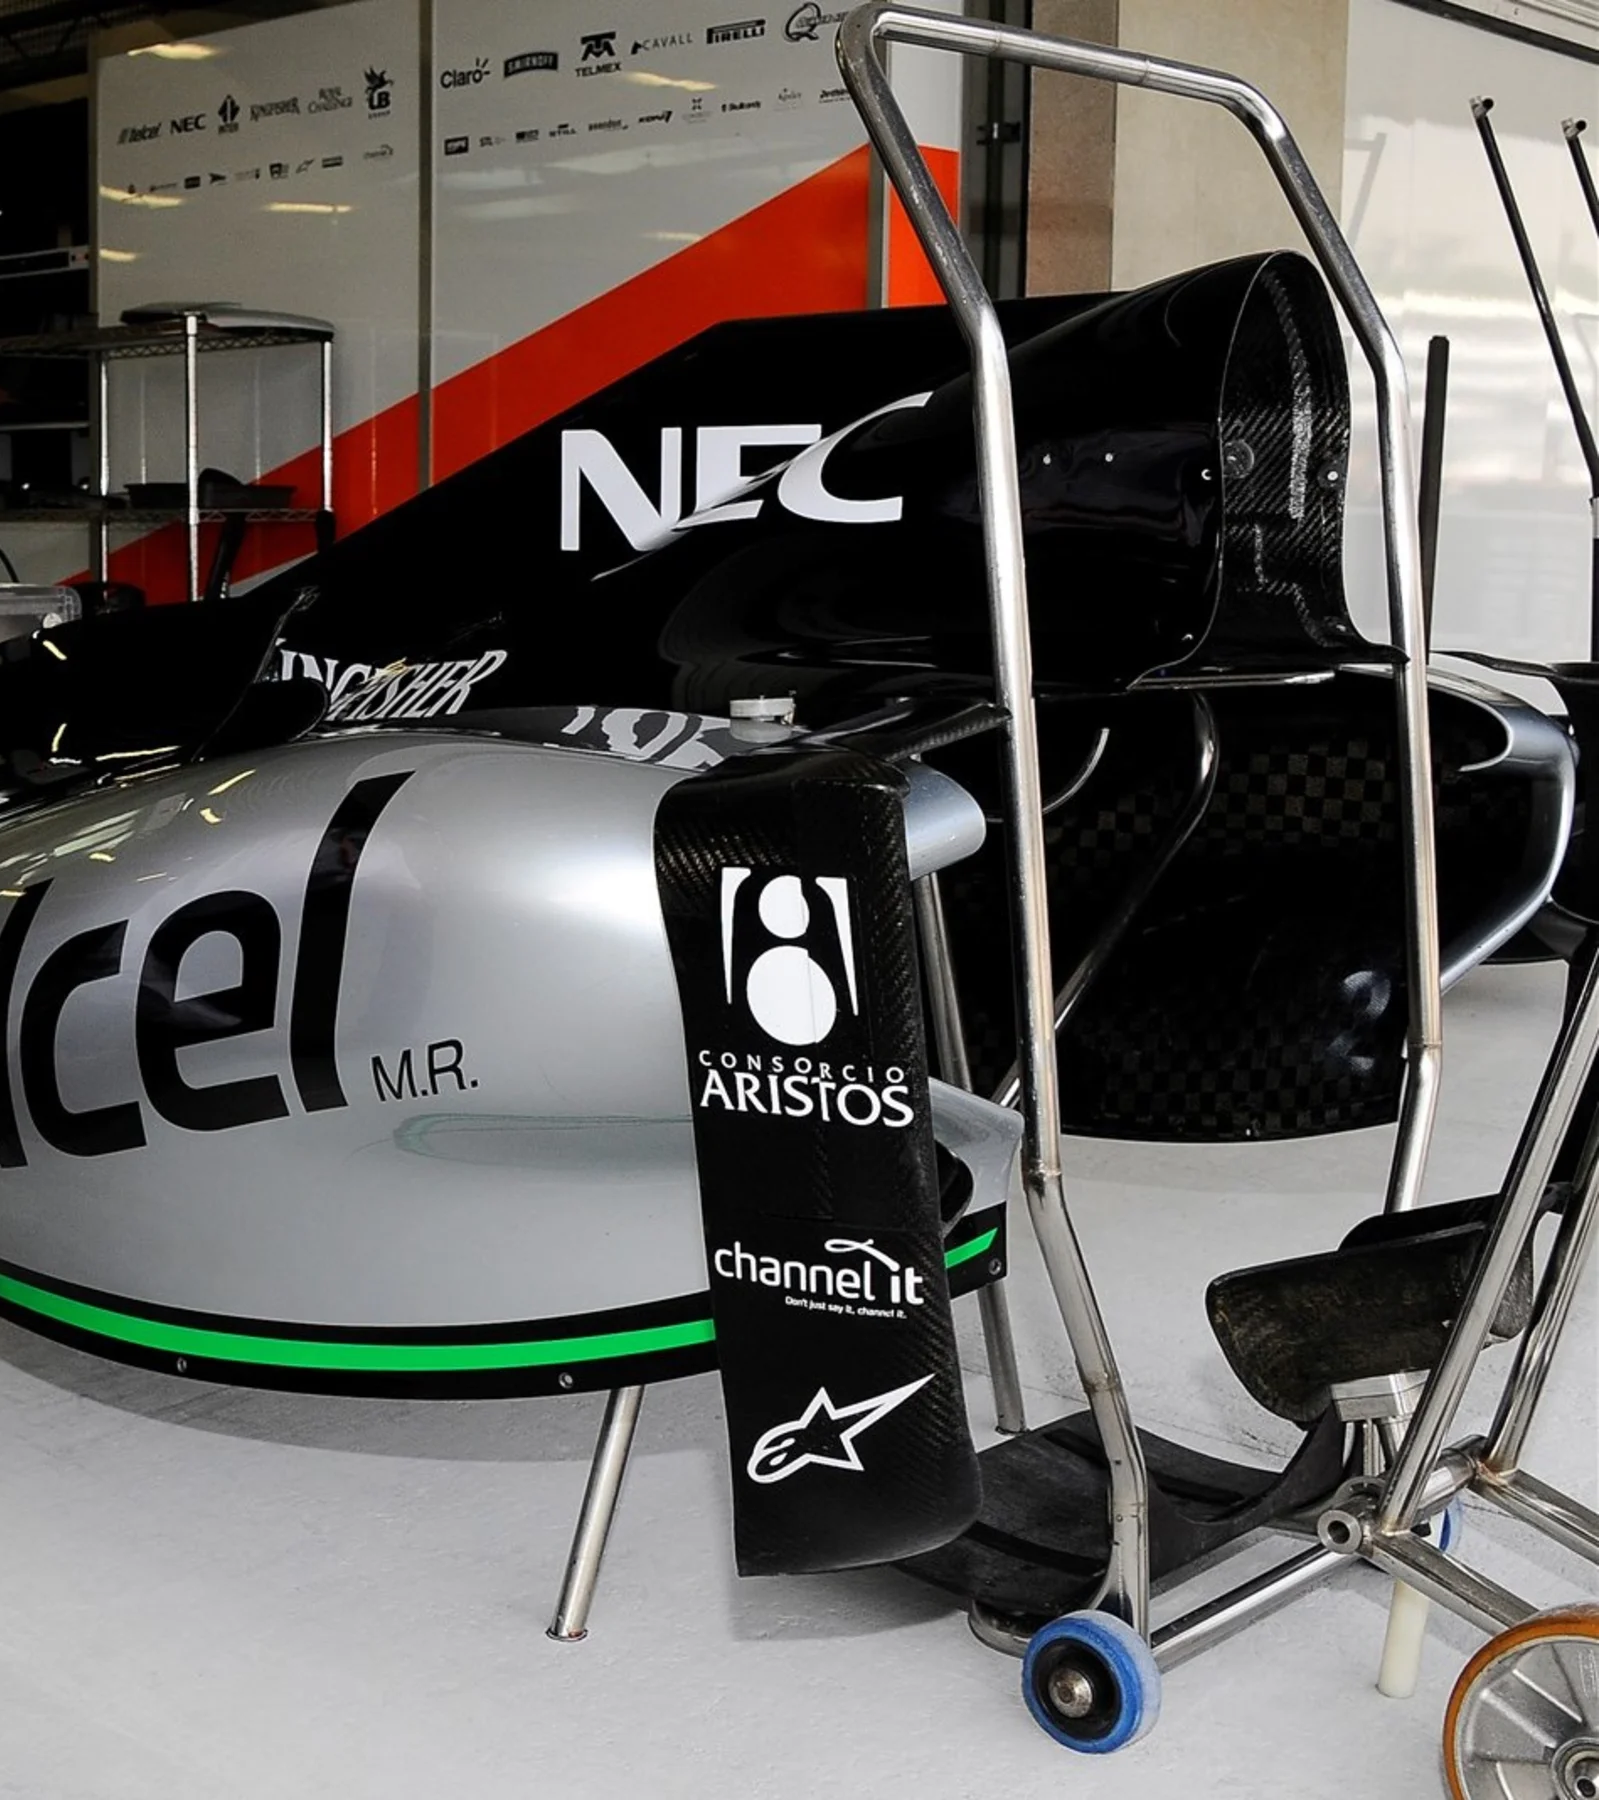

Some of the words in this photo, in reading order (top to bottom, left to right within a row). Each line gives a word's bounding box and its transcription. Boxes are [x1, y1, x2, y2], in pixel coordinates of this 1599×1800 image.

[707, 19, 766, 44] PIRELLI
[441, 67, 484, 89] Claro
[575, 61, 622, 78] TELMEX
[170, 113, 206, 135] NEC
[559, 391, 933, 553] NEC
[371, 1037, 480, 1104] M.R.
[698, 1049, 905, 1083] CONSORCIO
[699, 1068, 915, 1128] ARISTOS
[714, 1241, 876, 1301] channel
[889, 1264, 925, 1305] it
[784, 1295, 808, 1308] Don't
[827, 1303, 844, 1315] say
[857, 1306, 894, 1318] channel
